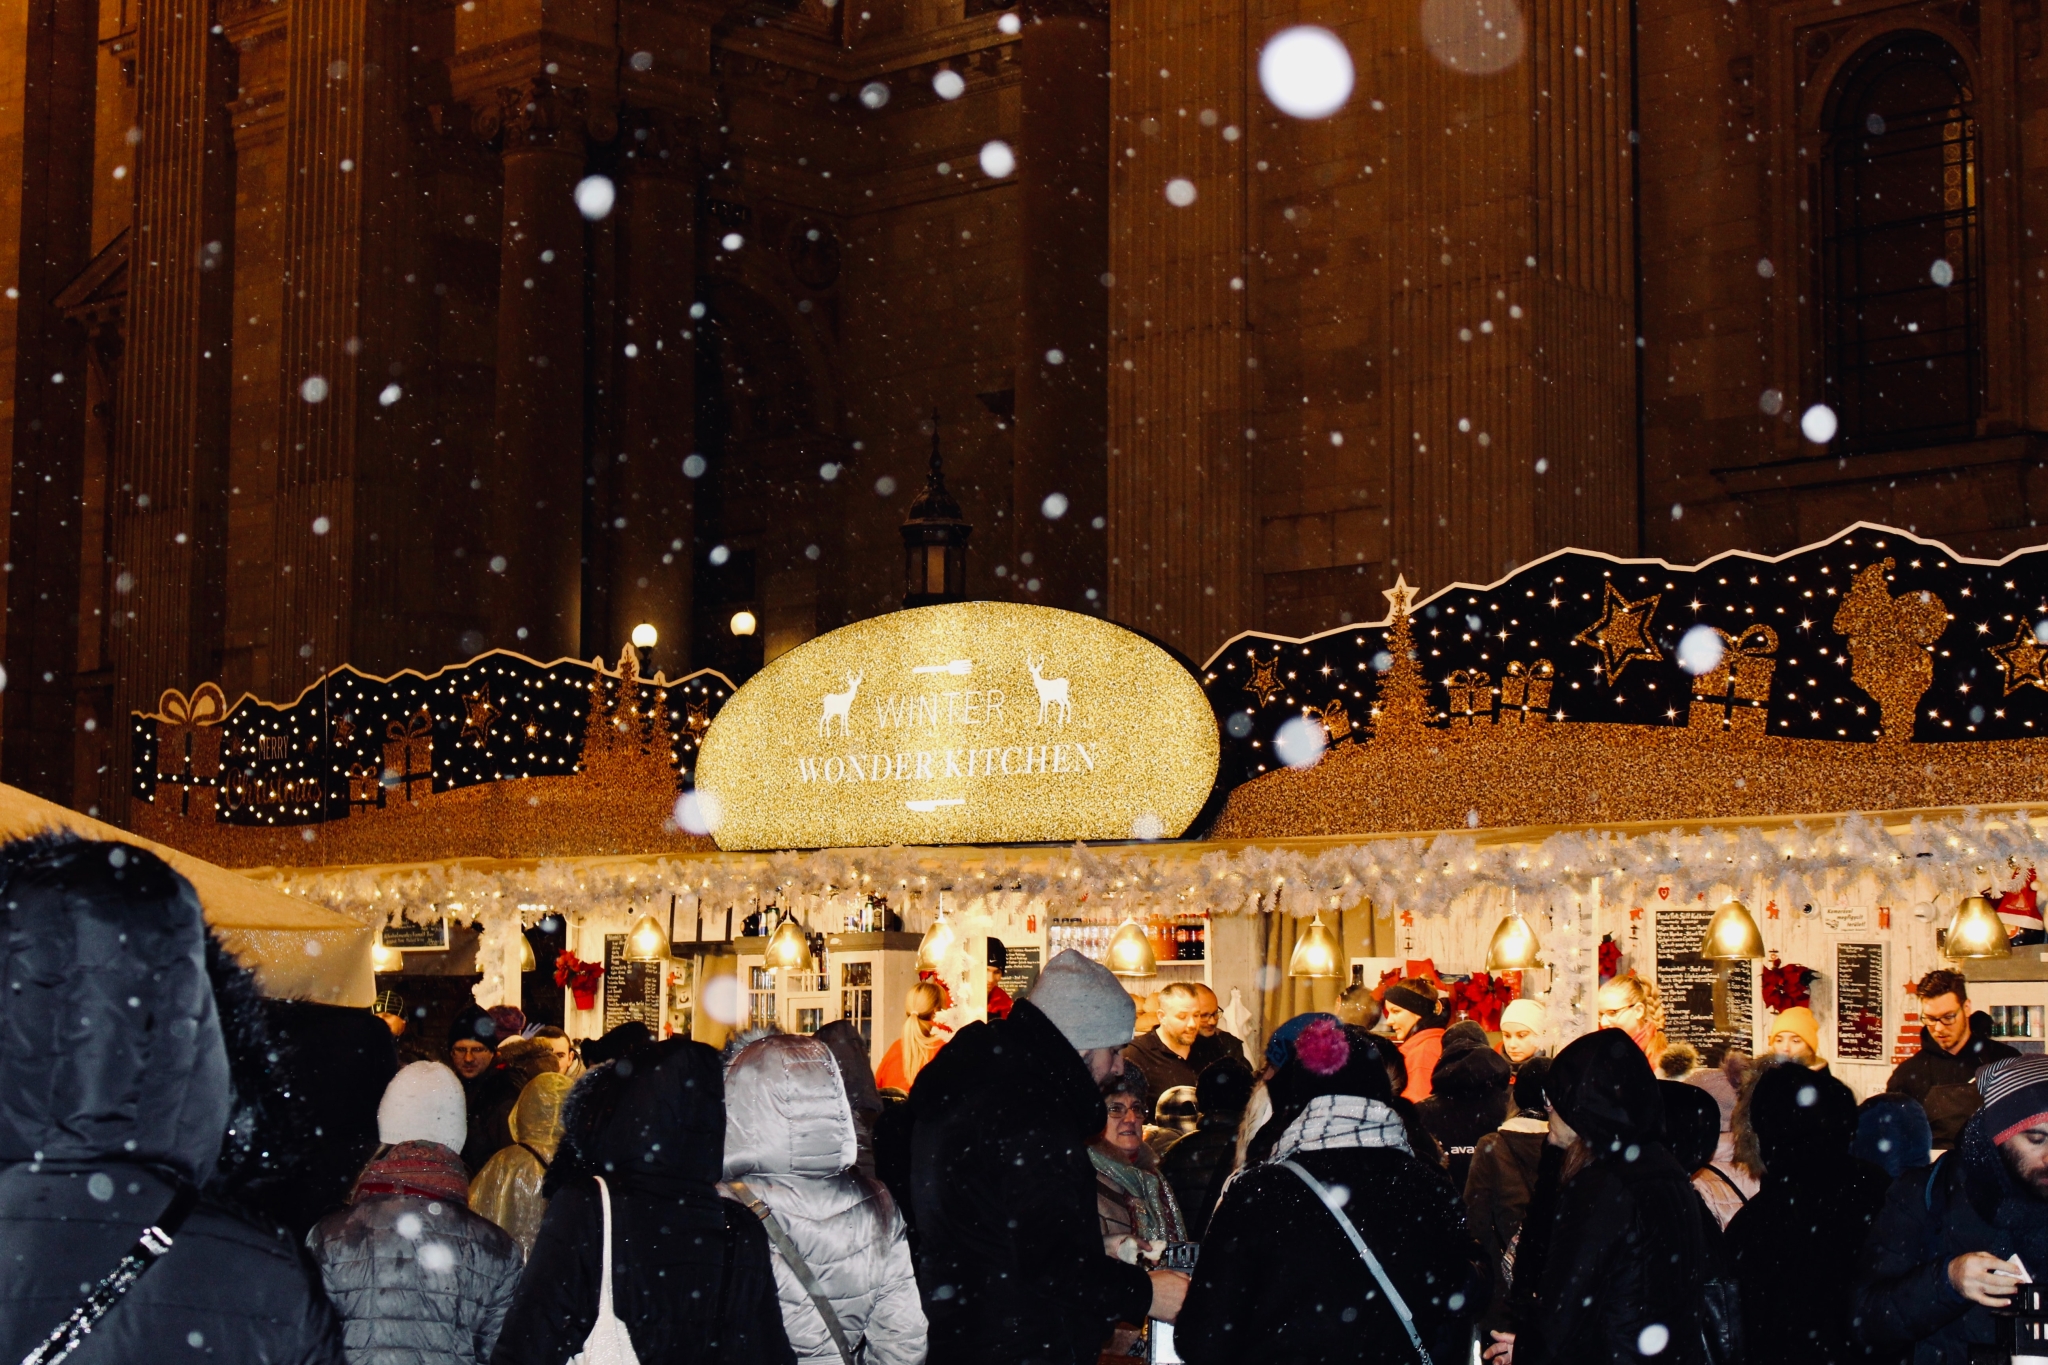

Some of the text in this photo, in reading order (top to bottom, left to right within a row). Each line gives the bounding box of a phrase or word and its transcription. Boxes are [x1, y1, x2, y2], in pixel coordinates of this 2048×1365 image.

[876, 689, 1006, 730] WINTER
[258, 735, 289, 760] MERRY
[800, 742, 1097, 784] WONDER KITCHEN
[225, 767, 322, 811] Christmas
[1450, 1145, 1477, 1154] ava
